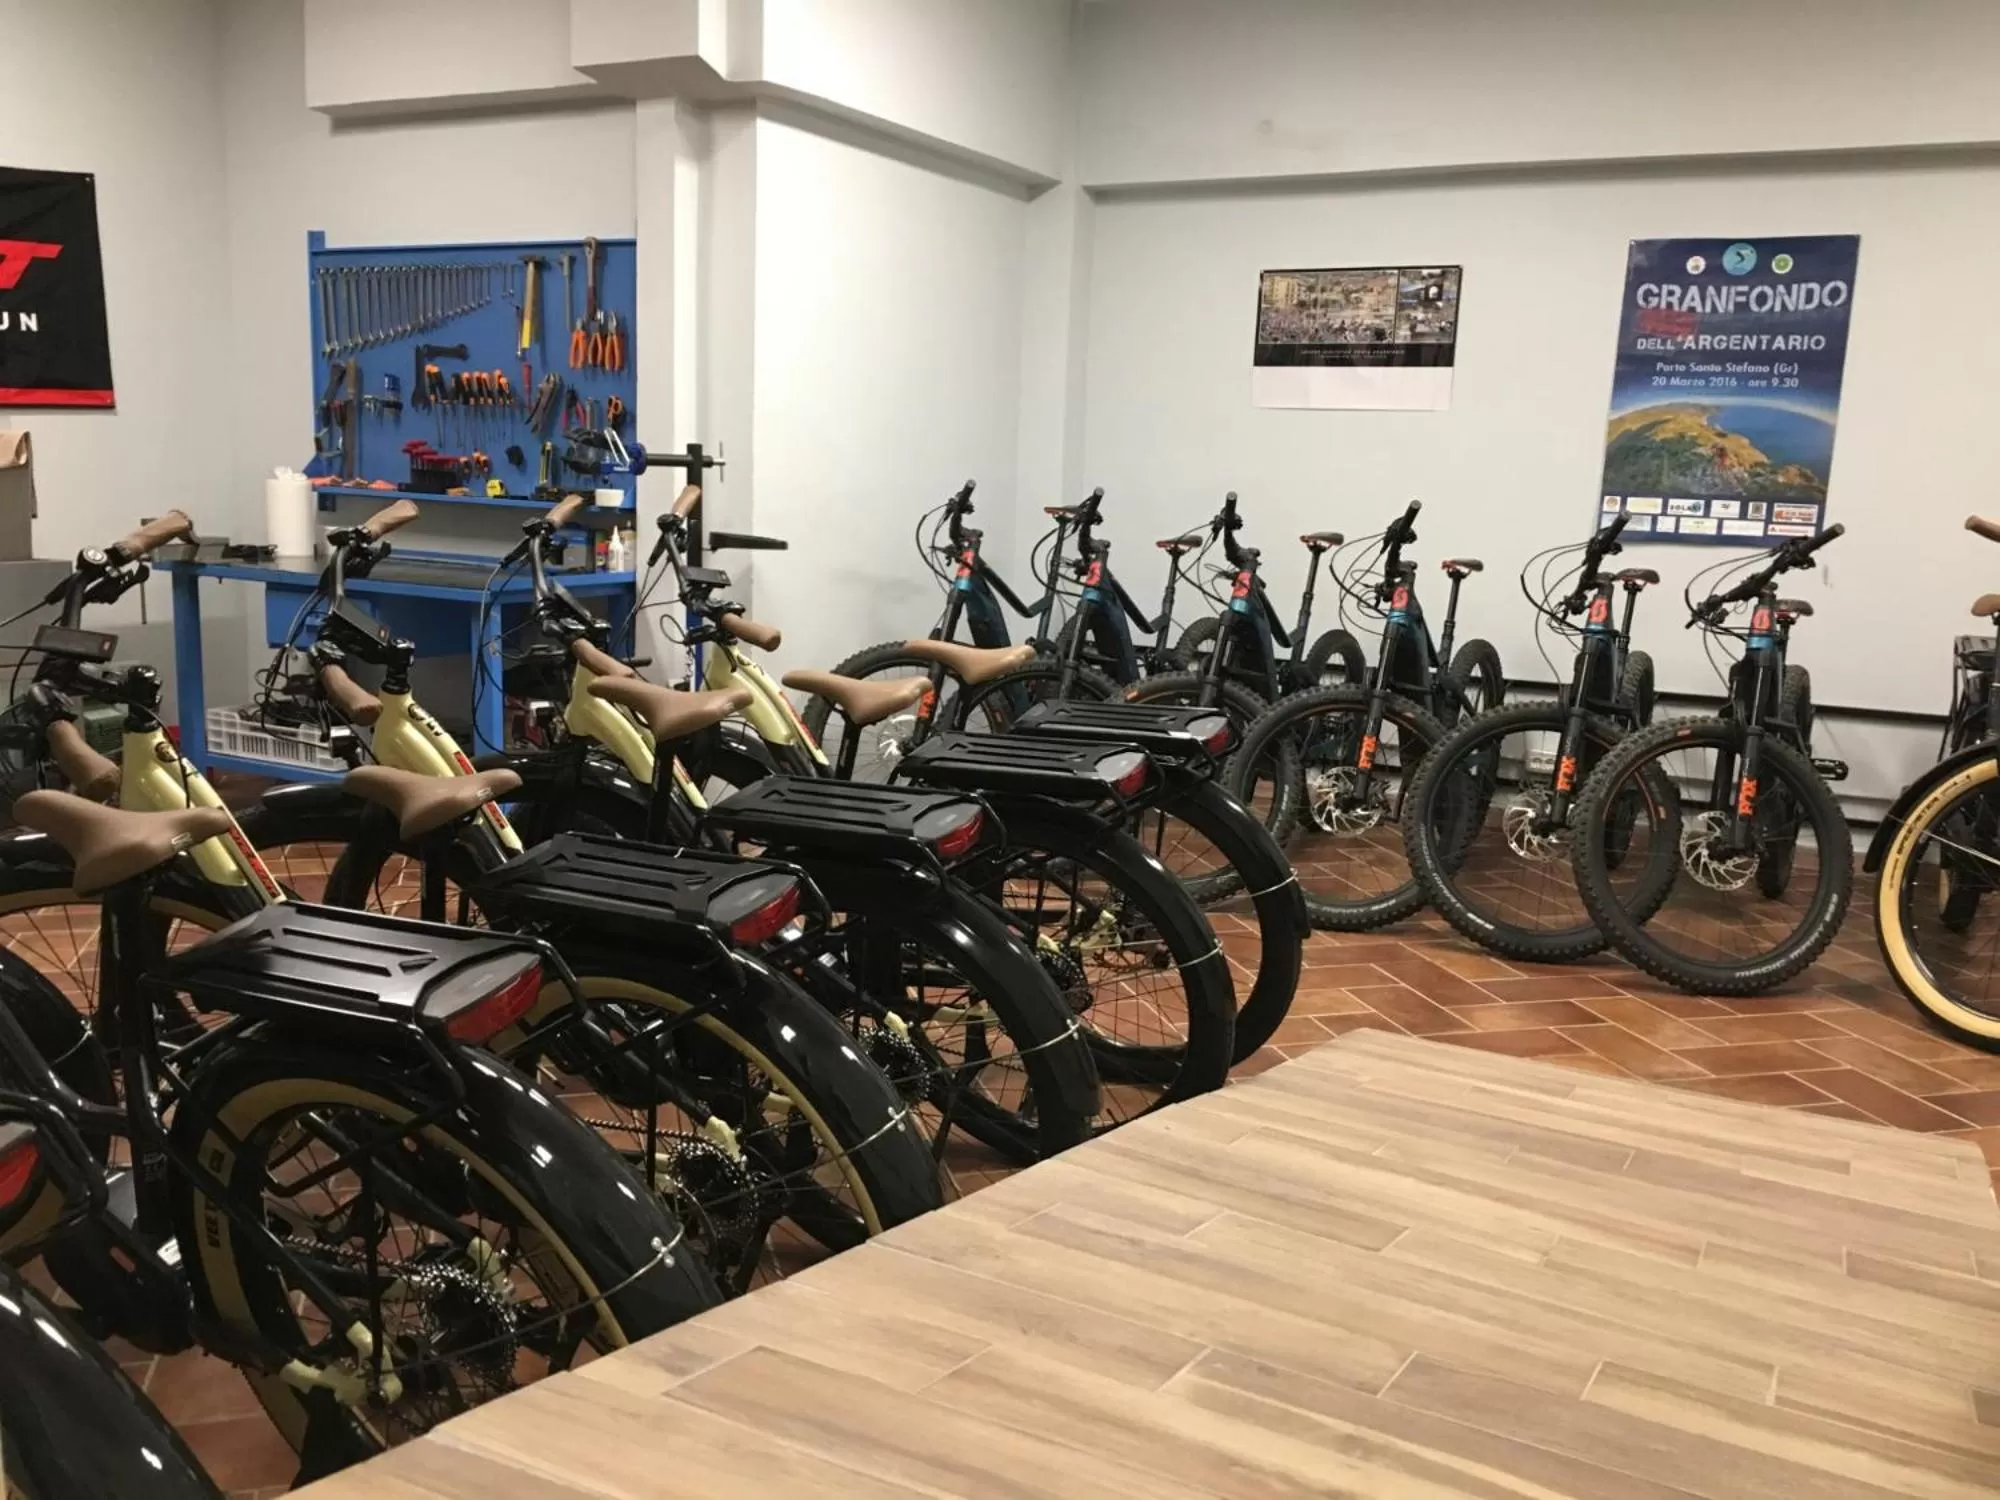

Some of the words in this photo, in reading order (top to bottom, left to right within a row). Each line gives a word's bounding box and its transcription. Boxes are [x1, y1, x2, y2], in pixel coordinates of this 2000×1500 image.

[1636, 280, 1848, 313] GRANFONDO
[1656, 361, 1686, 373] Porto
[1689, 362, 1722, 373] Santo
[1725, 362, 1770, 373] Stefano
[1773, 362, 1799, 375] (Gr)
[1652, 376, 1666, 386] 20
[1670, 376, 1706, 387] Marzo
[1709, 376, 1737, 387] 2016
[1748, 379, 1767, 387] ore
[1771, 377, 1800, 388] 9.30
